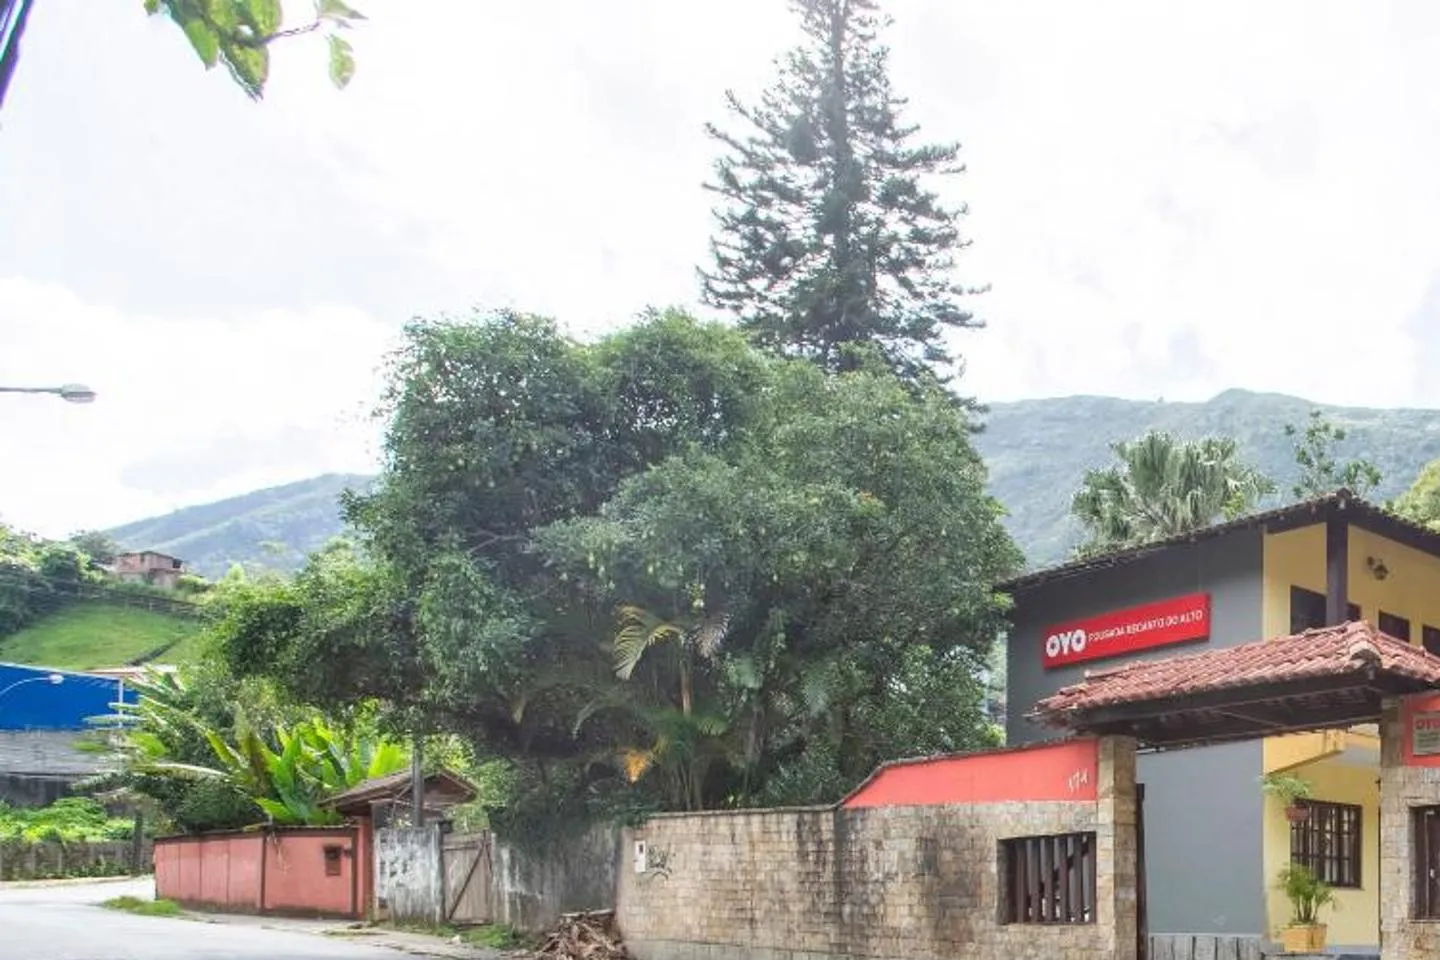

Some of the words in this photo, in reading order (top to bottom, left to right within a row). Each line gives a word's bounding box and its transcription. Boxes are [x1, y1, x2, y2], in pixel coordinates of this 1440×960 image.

[1165, 615, 1179, 628] DO
[1180, 609, 1203, 624] ALTO
[1046, 629, 1087, 657] OYO
